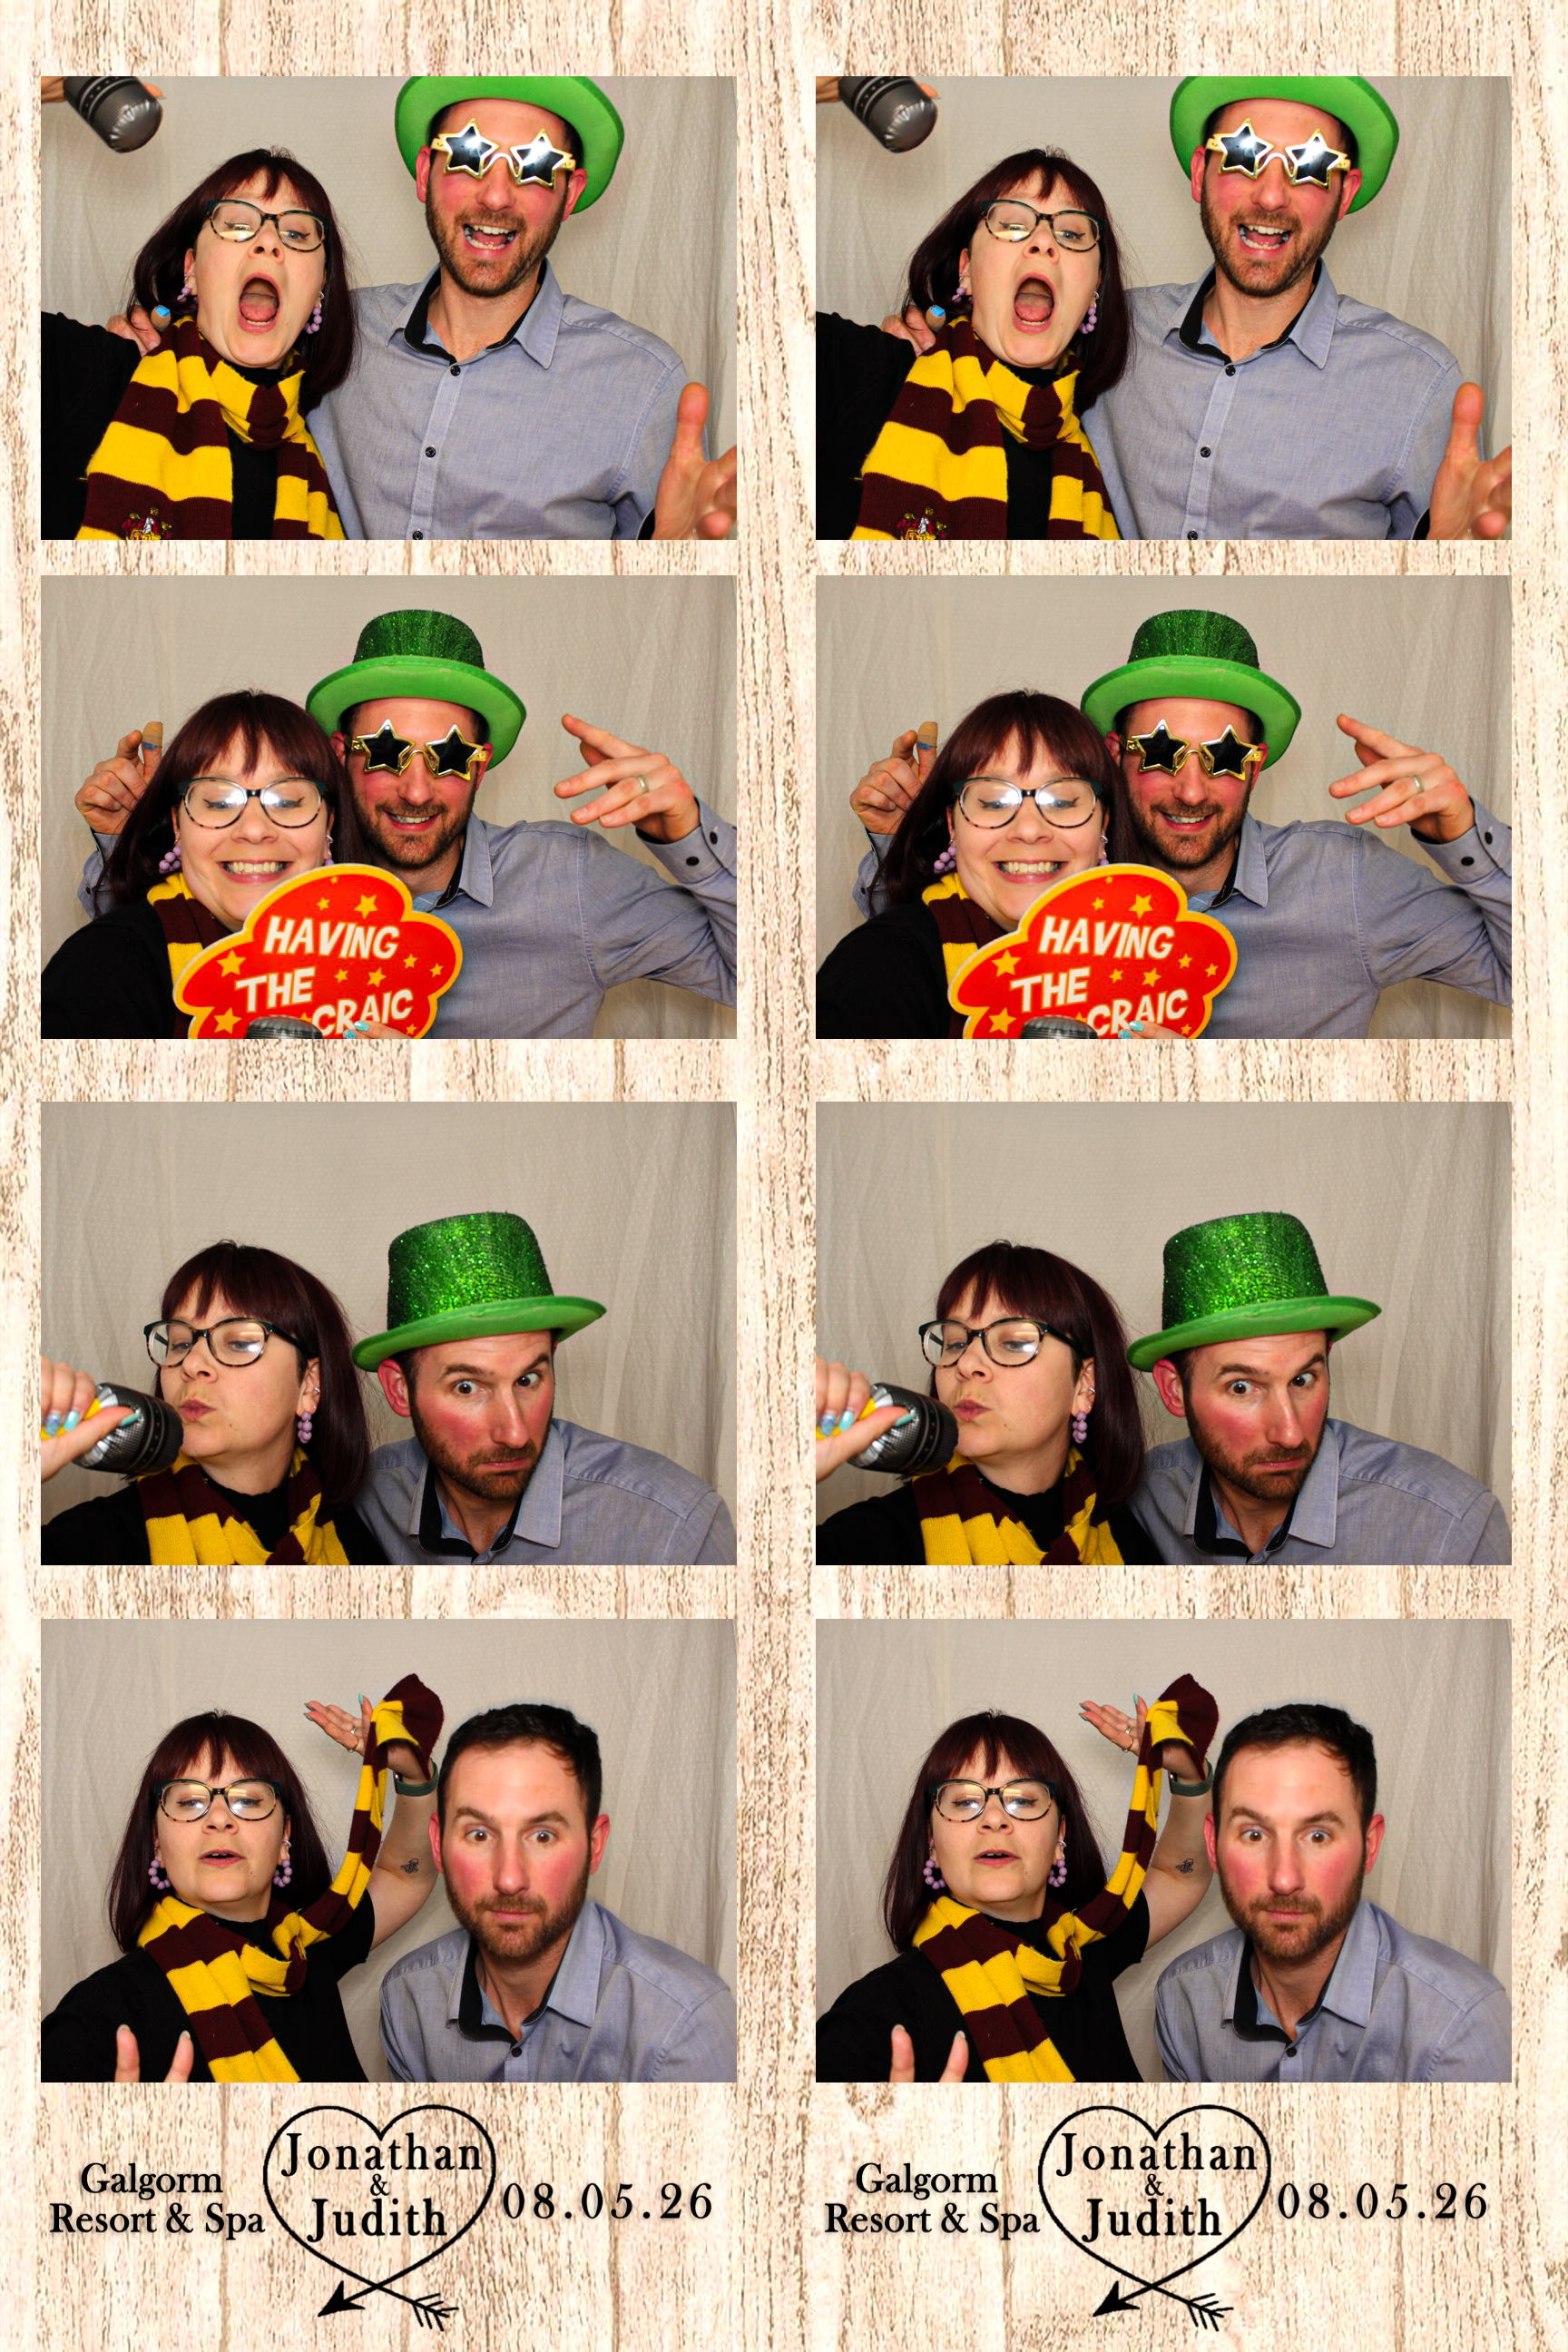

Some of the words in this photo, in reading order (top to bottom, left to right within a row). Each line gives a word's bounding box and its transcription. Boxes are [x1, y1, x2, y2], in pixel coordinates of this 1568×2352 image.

[264, 916, 399, 959] HAVING
[1039, 916, 1174, 959] HAVING
[235, 966, 316, 1013] THE
[311, 988, 413, 1036] CRAIC
[1010, 966, 1091, 1013] THE
[1086, 988, 1188, 1036] CRAIC
